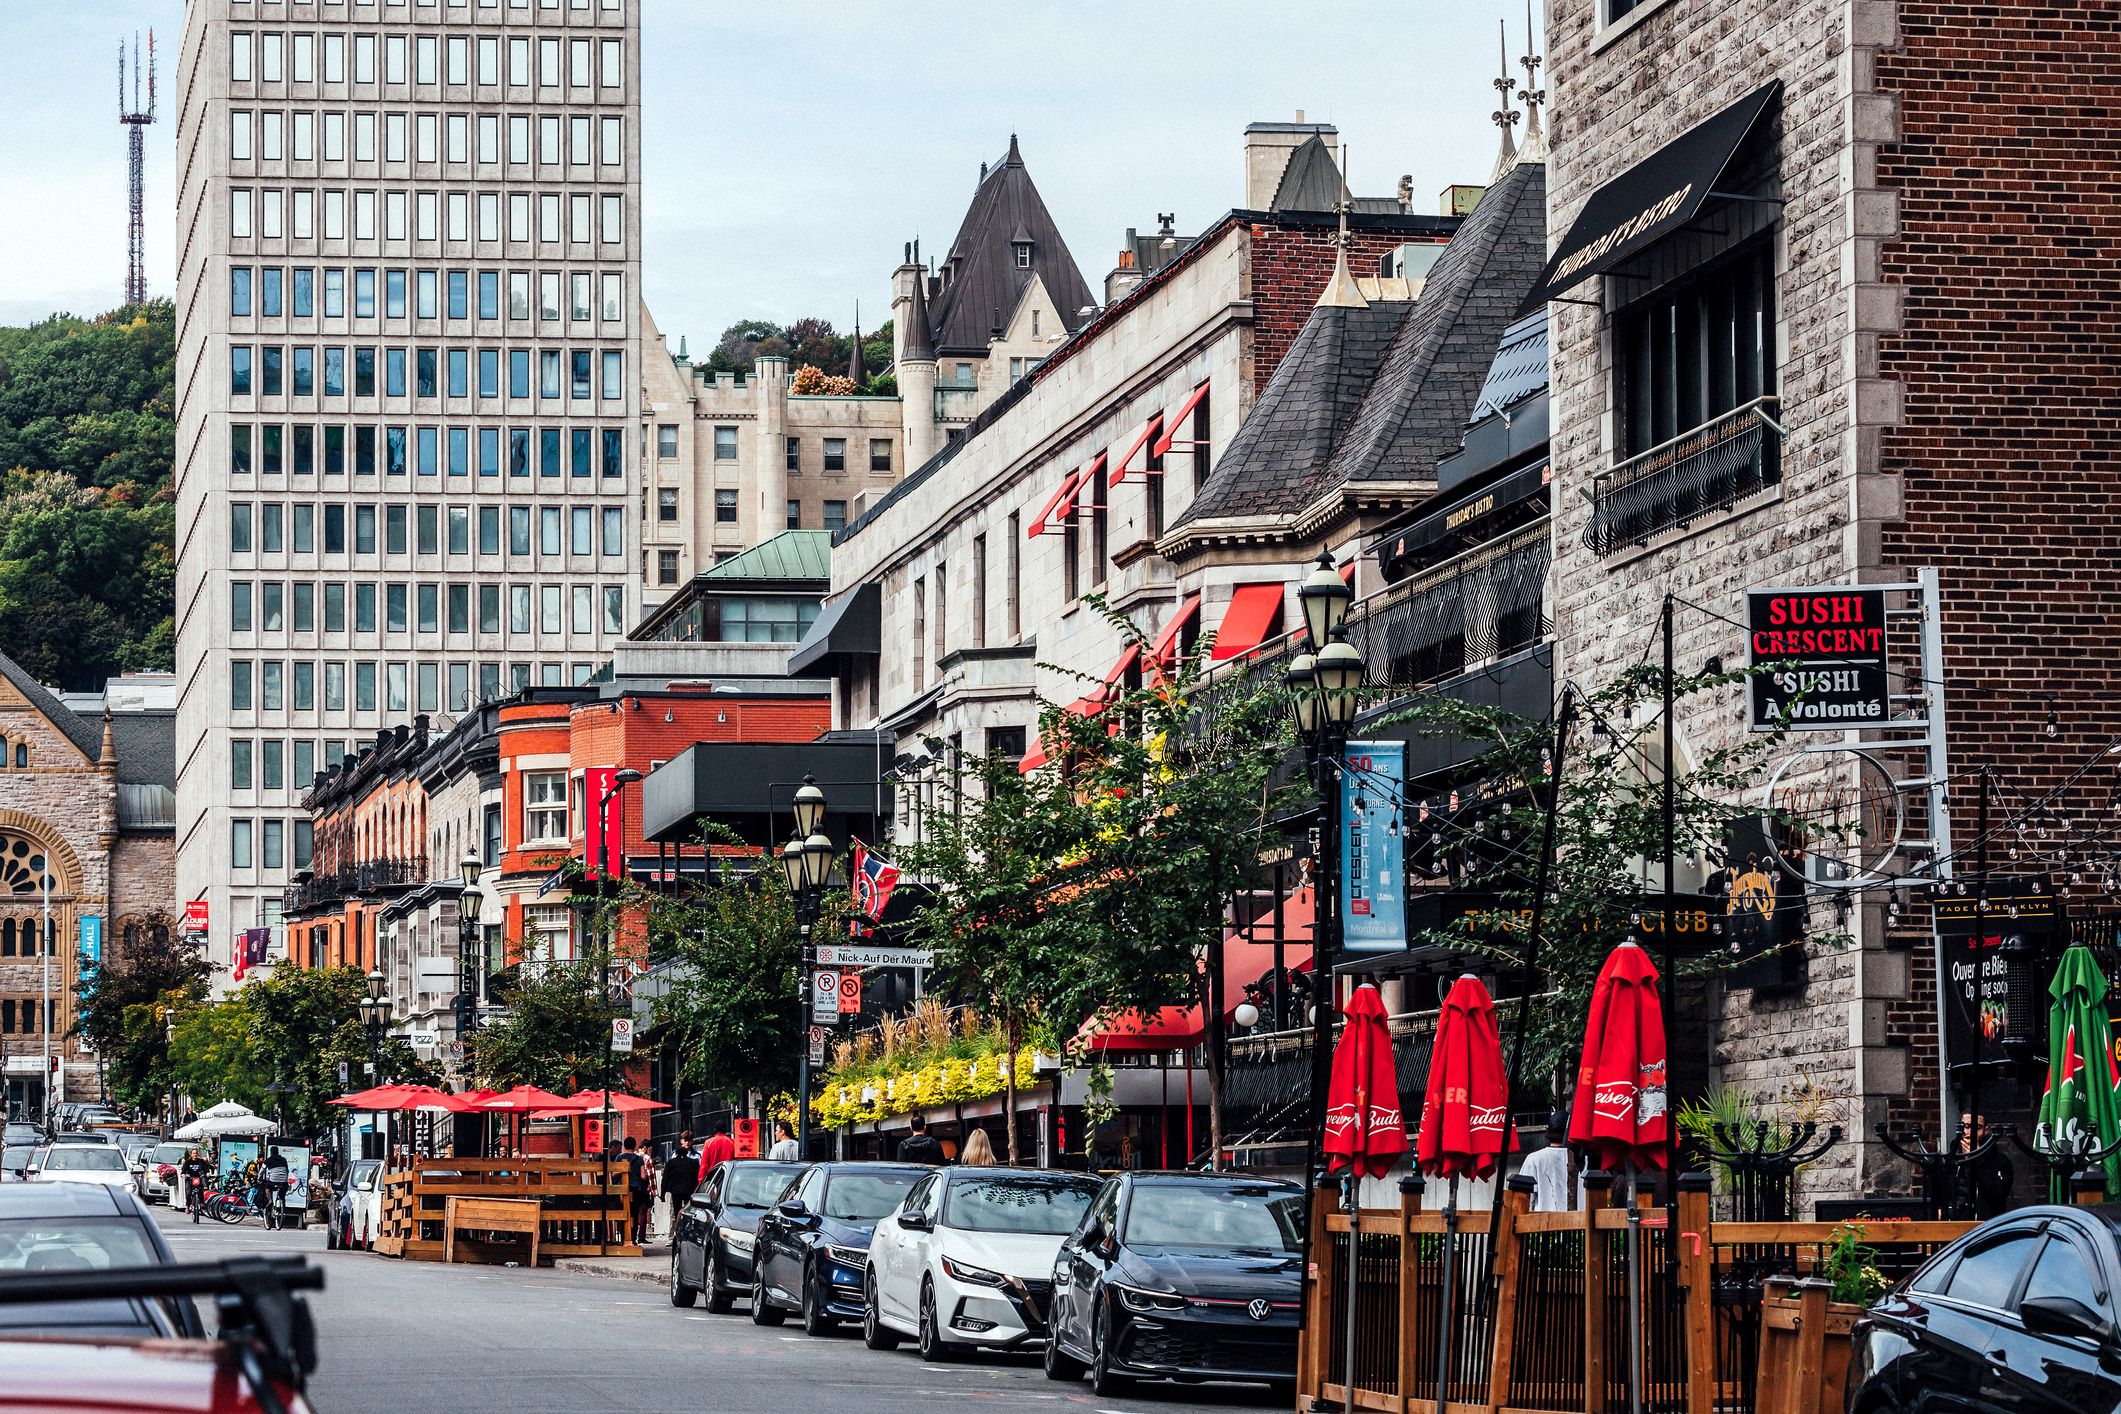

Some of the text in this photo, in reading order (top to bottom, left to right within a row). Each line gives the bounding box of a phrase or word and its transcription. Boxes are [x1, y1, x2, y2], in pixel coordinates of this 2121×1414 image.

[1547, 183, 1692, 287] THURSDAY'S BISTRO
[1446, 494, 1494, 530] THURSDAY'S BISTRO
[1770, 597, 1864, 625] SUSHI
[1753, 628, 1883, 655] CRESCENT
[1783, 670, 1860, 693] SUSHI
[1764, 698, 1881, 719] À Volonté
[1348, 755, 1389, 773] 50 ANS
[86, 924, 94, 949] HALL
[901, 955, 926, 965] Maur
